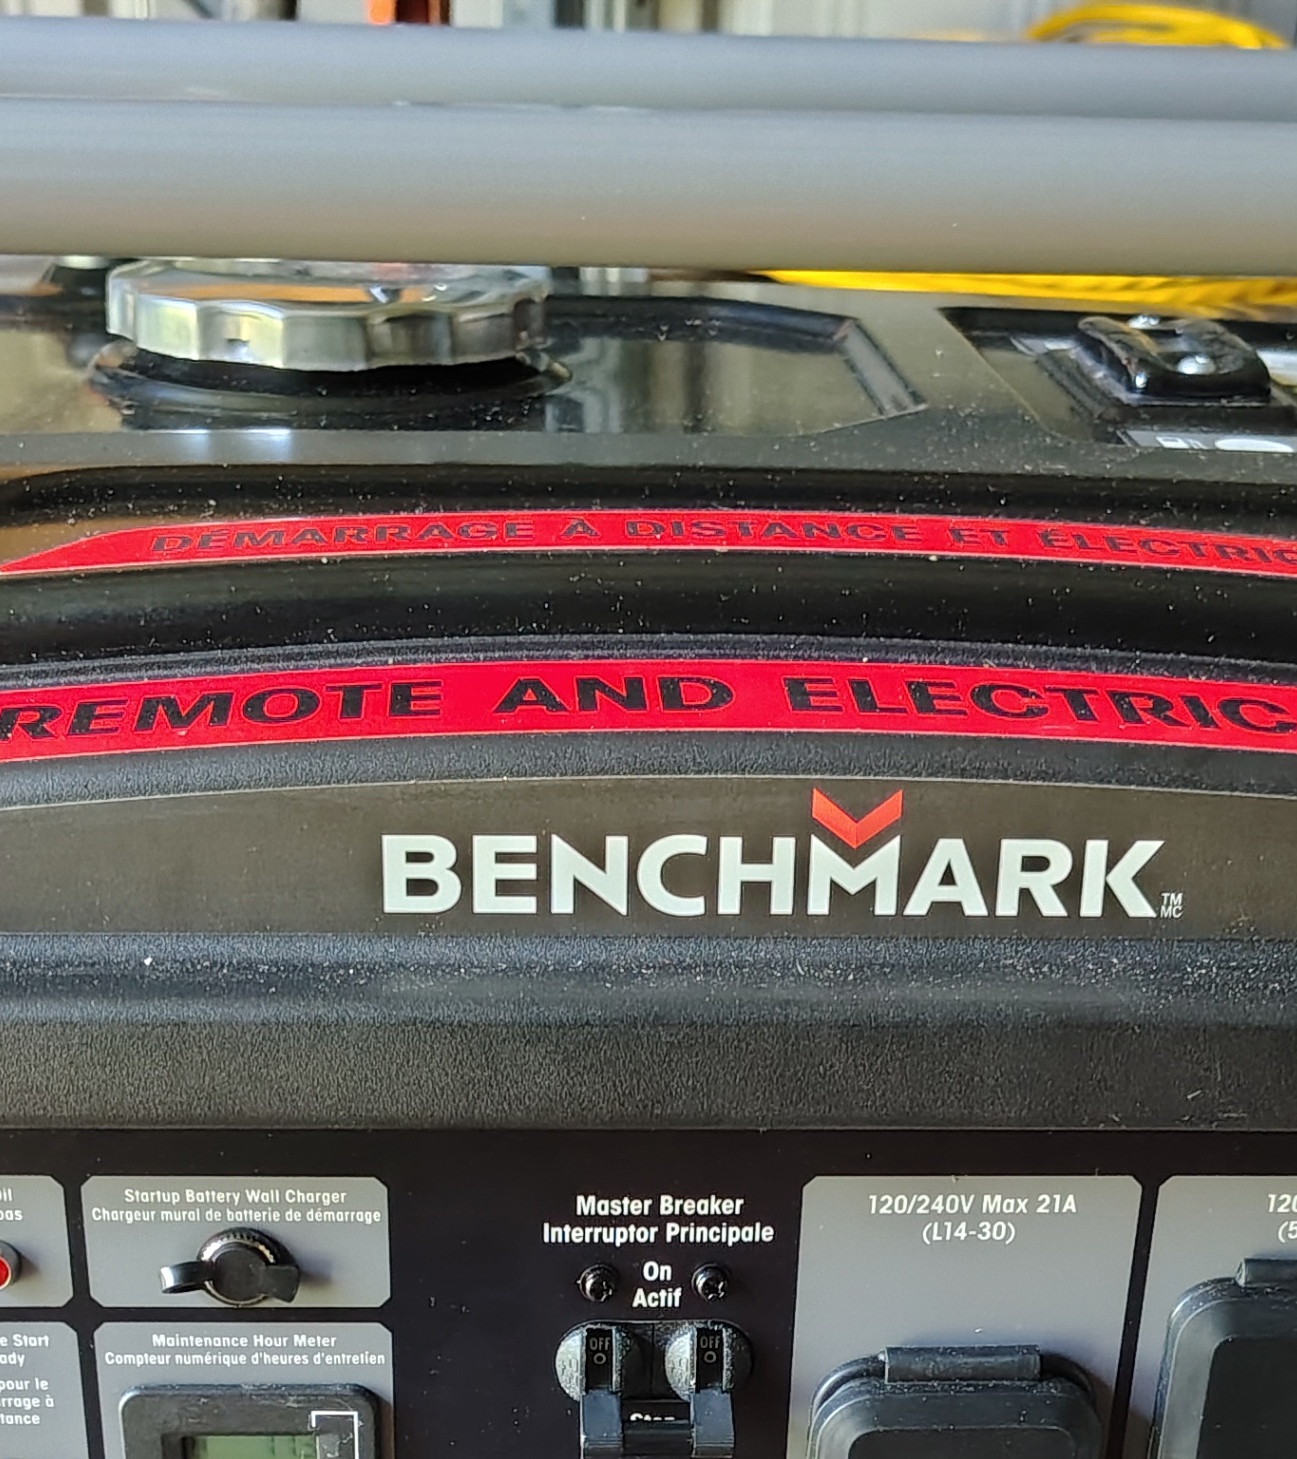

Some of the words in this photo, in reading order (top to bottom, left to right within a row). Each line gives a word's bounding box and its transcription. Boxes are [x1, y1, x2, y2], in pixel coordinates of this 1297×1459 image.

[150, 520, 534, 553] DÉMARRAGE
[560, 518, 601, 538] À
[625, 519, 924, 543] DISTANCE
[948, 528, 1010, 548] ET
[495, 675, 733, 714] AND
[380, 833, 1166, 918] BENCHMARK
[124, 1188, 180, 1206] Startup
[185, 1188, 241, 1206] Battery
[245, 1188, 280, 1203] Wall
[285, 1188, 348, 1206] Charger
[575, 1194, 653, 1216] Master
[659, 1194, 745, 1216] Breaker
[867, 1193, 975, 1216] 120/240V
[981, 1193, 1029, 1216] Max
[1035, 1193, 1078, 1215] 21A
[91, 1207, 156, 1224] Chargeur
[160, 1207, 201, 1222] mural
[205, 1207, 222, 1222] de
[226, 1207, 282, 1222] batterie
[285, 1207, 302, 1222] de
[306, 1206, 382, 1225] démarrage
[543, 1222, 659, 1248] Interruptor
[665, 1222, 775, 1248] Principale
[921, 1219, 1017, 1245] (L14-30)
[642, 1261, 673, 1282] On
[632, 1287, 682, 1309] Actif
[13, 1333, 50, 1348] Start
[152, 1333, 248, 1348] Maintenance
[252, 1333, 290, 1348] Hour
[293, 1333, 337, 1348] Meter
[589, 1336, 611, 1351] OFF
[699, 1335, 721, 1350] OFF
[104, 1351, 172, 1367] Compteur
[175, 1351, 247, 1367] numérique
[251, 1351, 310, 1367] d'heures
[313, 1351, 386, 1366] d'entretien
[34, 1378, 49, 1392] le
[45, 1394, 55, 1409] à
